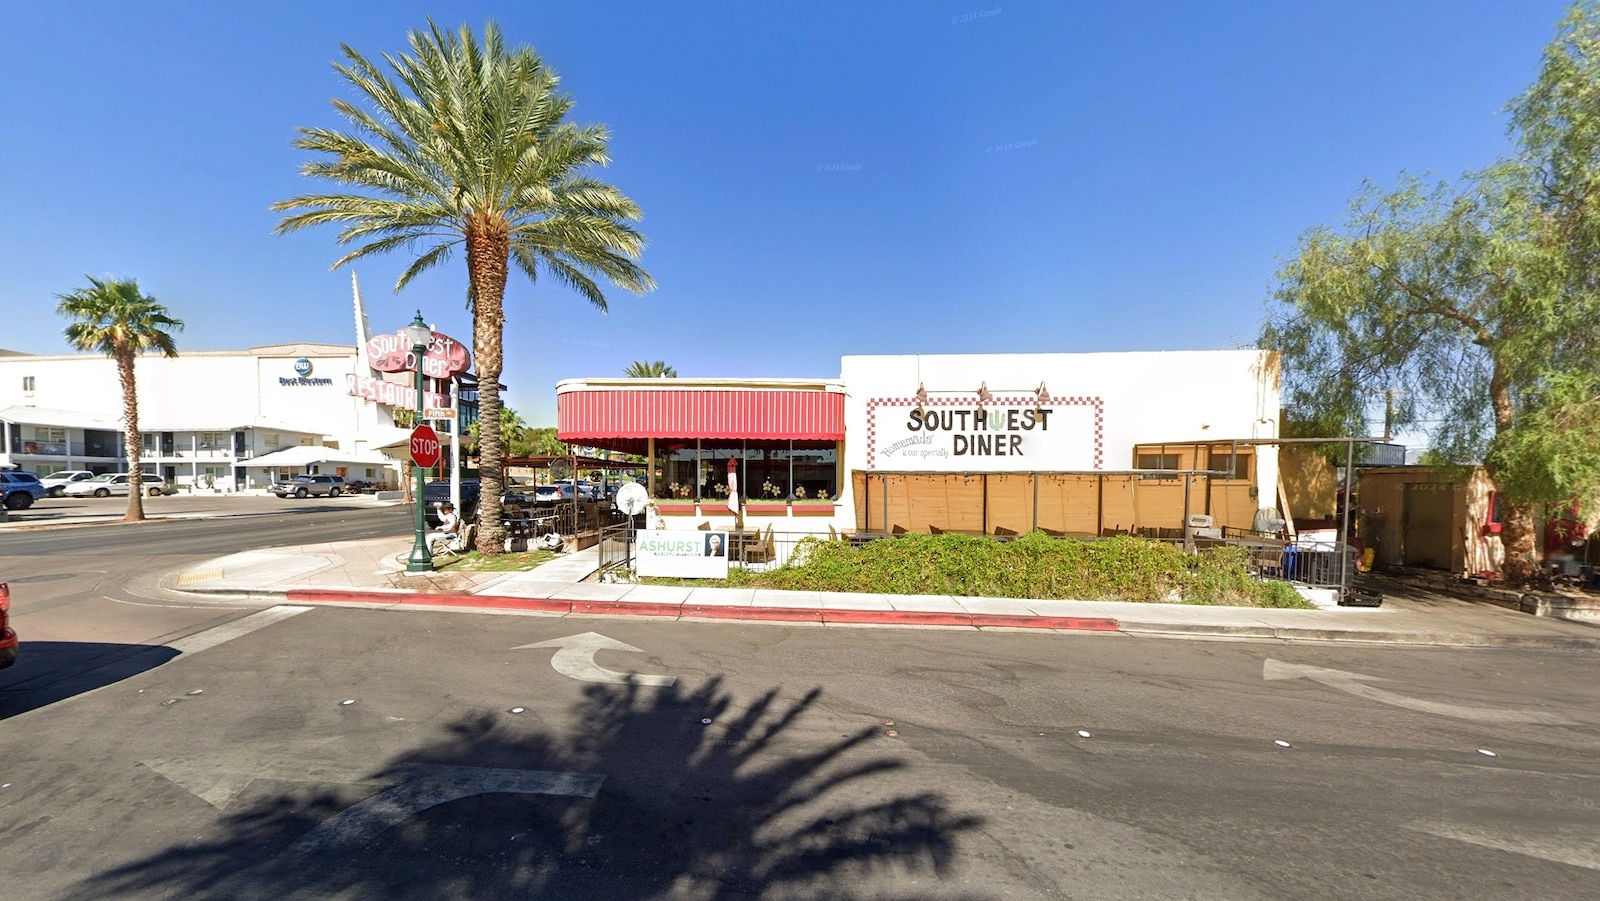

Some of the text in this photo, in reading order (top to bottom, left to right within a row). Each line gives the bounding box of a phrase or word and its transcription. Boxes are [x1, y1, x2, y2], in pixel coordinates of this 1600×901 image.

[369, 329, 453, 359] Southest
[295, 362, 309, 370] BW
[405, 351, 447, 377] Dner
[347, 374, 444, 410] RESTAURNT
[428, 410, 445, 418] Fifth
[906, 408, 1053, 431] SOUTHWEST
[412, 437, 438, 455] STOP
[953, 434, 1024, 456] DINER
[639, 541, 701, 552] ASHURST
